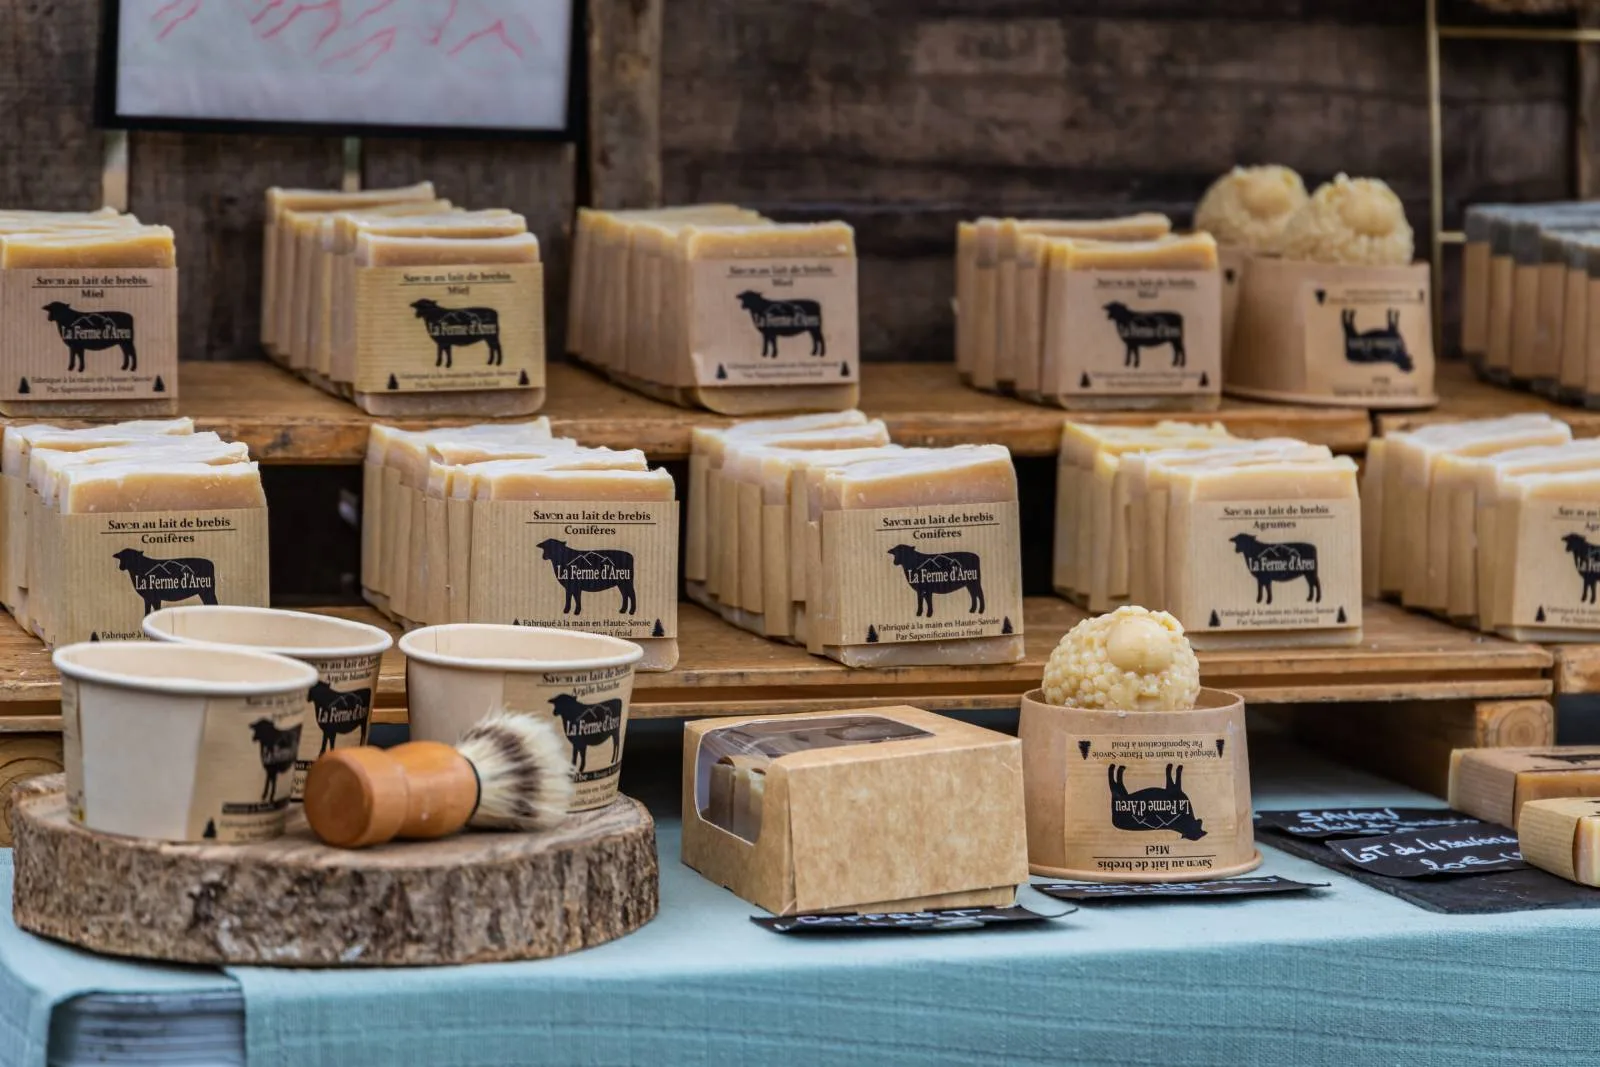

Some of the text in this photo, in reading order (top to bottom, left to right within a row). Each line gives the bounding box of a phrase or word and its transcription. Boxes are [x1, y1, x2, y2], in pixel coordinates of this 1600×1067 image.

[82, 276, 98, 285] lait
[101, 275, 113, 284] de
[116, 275, 147, 284] brebis
[82, 290, 104, 298] Miel
[62, 325, 131, 339] La Ferme d'Areu
[1268, 507, 1284, 515] lait
[1286, 506, 1298, 514] de
[1300, 505, 1329, 513] brebis
[566, 512, 579, 520] au
[582, 511, 600, 520] lait
[602, 511, 615, 520] de
[618, 511, 651, 520] brebis
[914, 517, 926, 525] au
[929, 515, 945, 524] lait
[948, 514, 960, 523] de
[963, 512, 993, 522] brebis
[159, 518, 177, 528] lait
[180, 518, 193, 527] de
[196, 518, 231, 527] brebis
[1253, 521, 1296, 531] Agrumes
[565, 525, 616, 534] Conifères
[913, 529, 962, 539] Conifères
[141, 534, 195, 543] Conifères
[1249, 556, 1314, 571] La Ferme d'Areu
[557, 565, 630, 579] La Ferme d'Areu
[909, 567, 977, 583] La Ferme d'Areu
[135, 573, 211, 590] La Ferme d'Areu
[523, 619, 555, 627] Fabriqué
[603, 619, 650, 627] Haute-Savoie
[879, 624, 909, 632] Fabriqué
[955, 618, 999, 626] Haute-Savoie
[909, 630, 960, 641] Saponification
[575, 673, 587, 682] au
[590, 671, 603, 681] lait
[605, 670, 613, 678] de
[572, 681, 620, 696] Argile blanche
[318, 708, 328, 722] La
[330, 706, 351, 722] Ferme
[566, 720, 577, 736] La
[579, 720, 601, 735] Ferme
[1115, 800, 1189, 815] La Ferme d'Areu
[1145, 845, 1169, 854] Miel
[1098, 861, 1134, 871] brebis
[1137, 861, 1148, 870] de
[1152, 861, 1169, 870] lait
[1171, 860, 1184, 868] au
